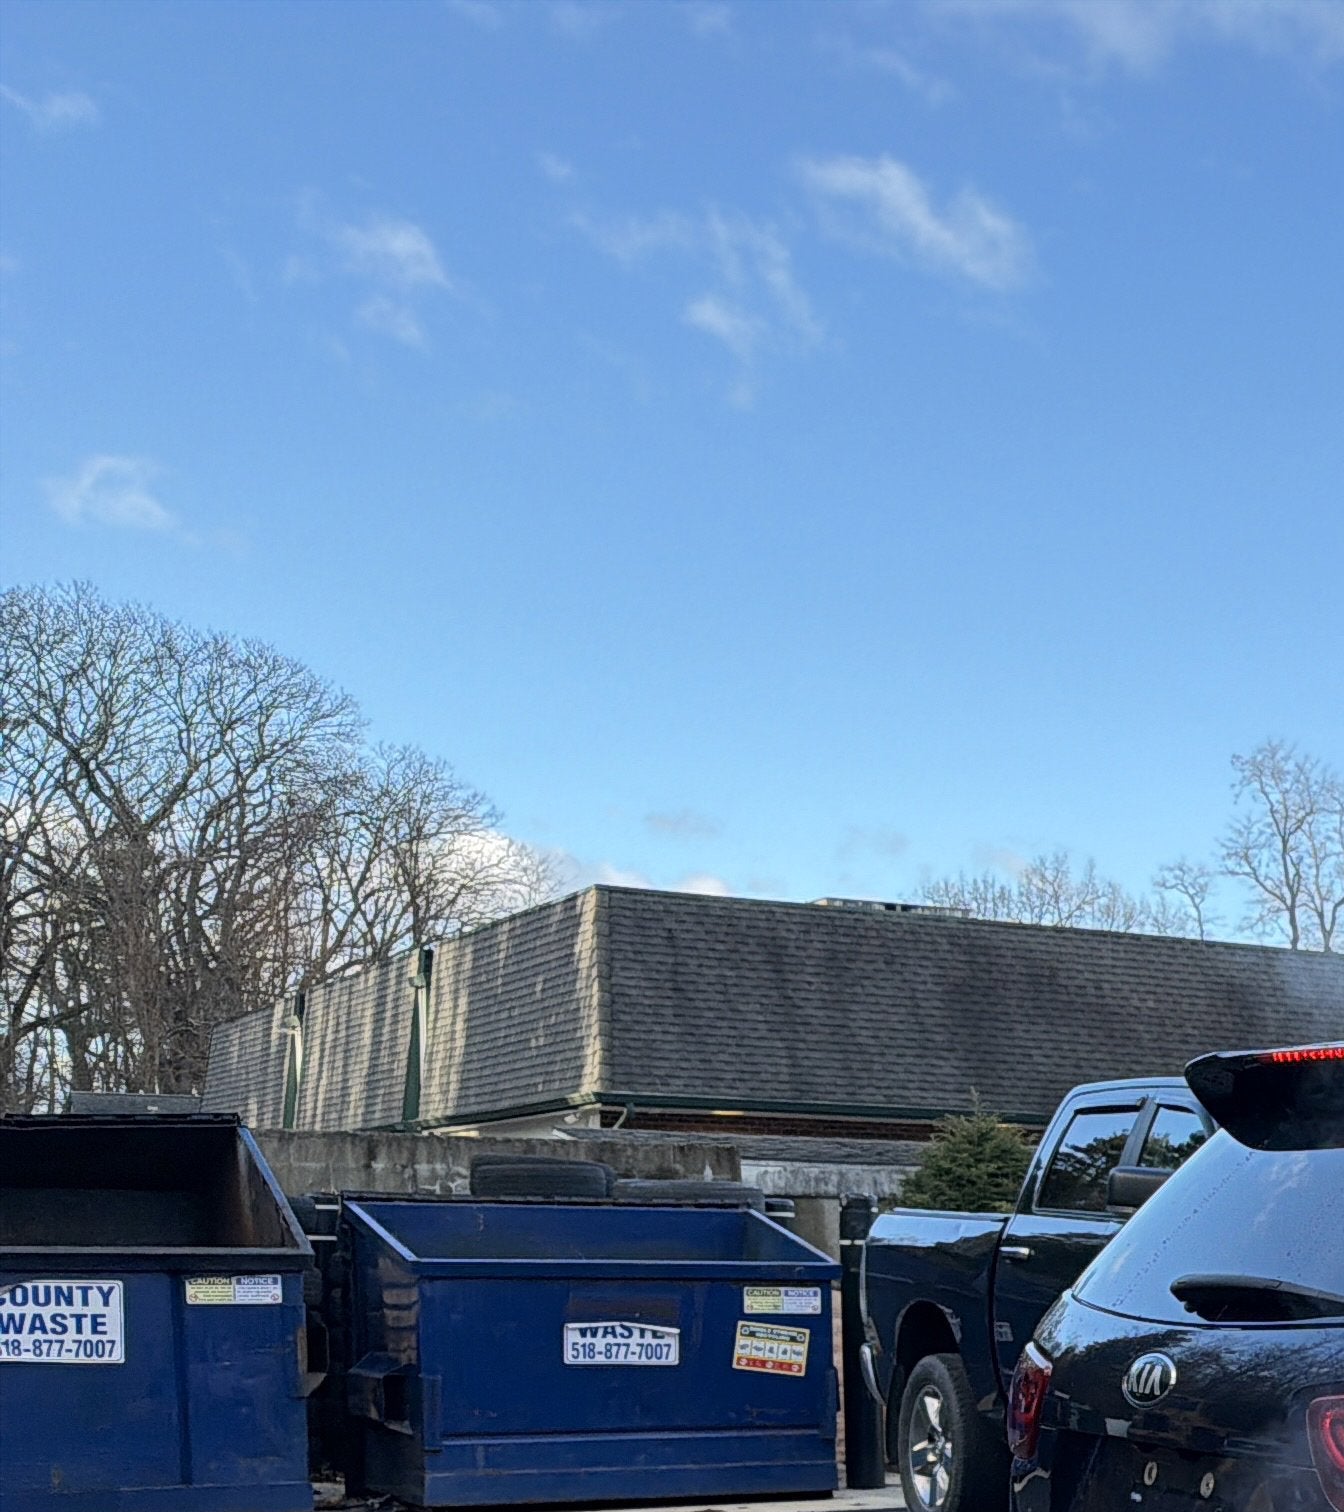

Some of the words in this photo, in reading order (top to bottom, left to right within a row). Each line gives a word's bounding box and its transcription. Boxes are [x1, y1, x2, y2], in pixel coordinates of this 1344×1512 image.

[240, 1277, 274, 1285] NOTICE
[747, 1288, 781, 1297] CAUTION
[787, 1289, 816, 1298] NOTICE
[0, 1312, 108, 1336] WASTE
[0, 1338, 117, 1359] 18-877-7007
[571, 1341, 673, 1361] 518-877-7007
[1127, 1362, 1163, 1396] KIA
